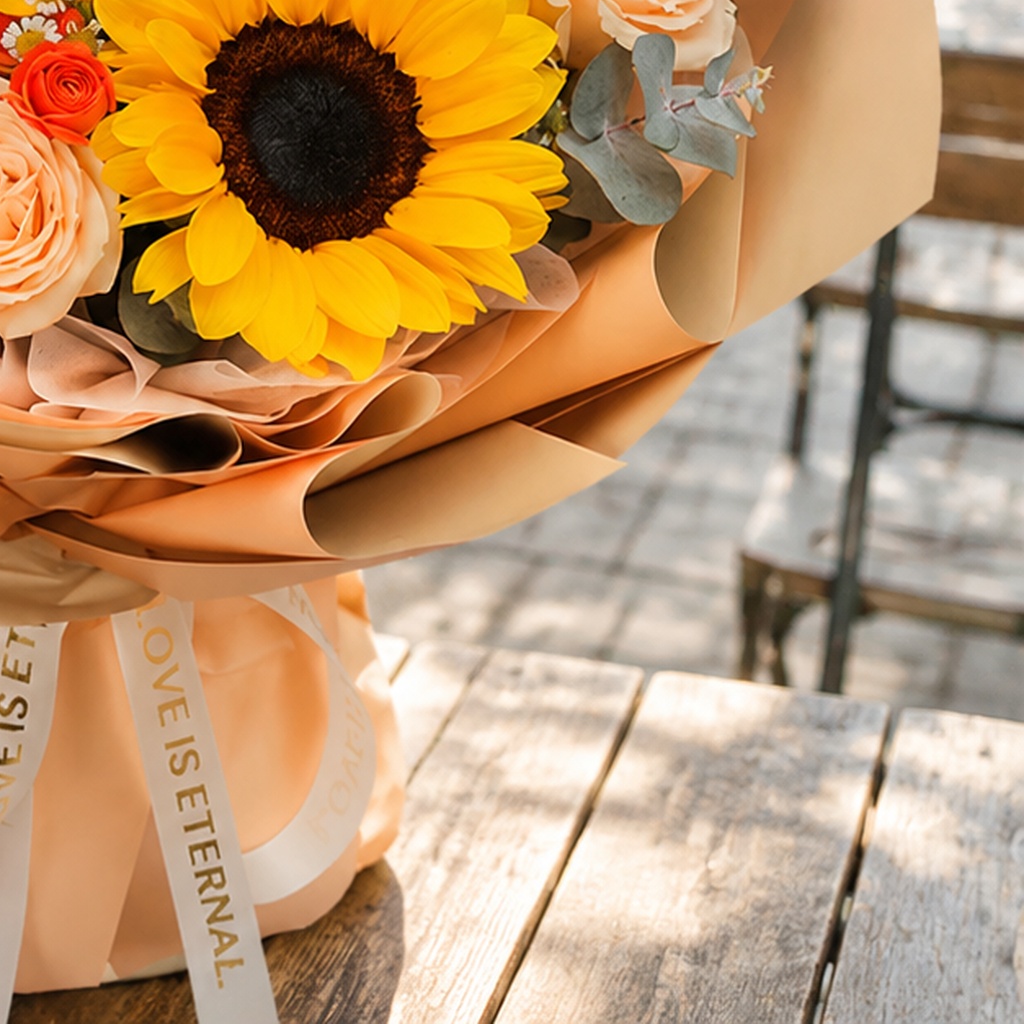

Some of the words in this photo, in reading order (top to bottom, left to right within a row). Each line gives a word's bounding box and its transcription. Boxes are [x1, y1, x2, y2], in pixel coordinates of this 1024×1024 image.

[1, 624, 38, 684] ET
[164, 735, 201, 777] IS
[176, 784, 244, 989] ETERNAL
